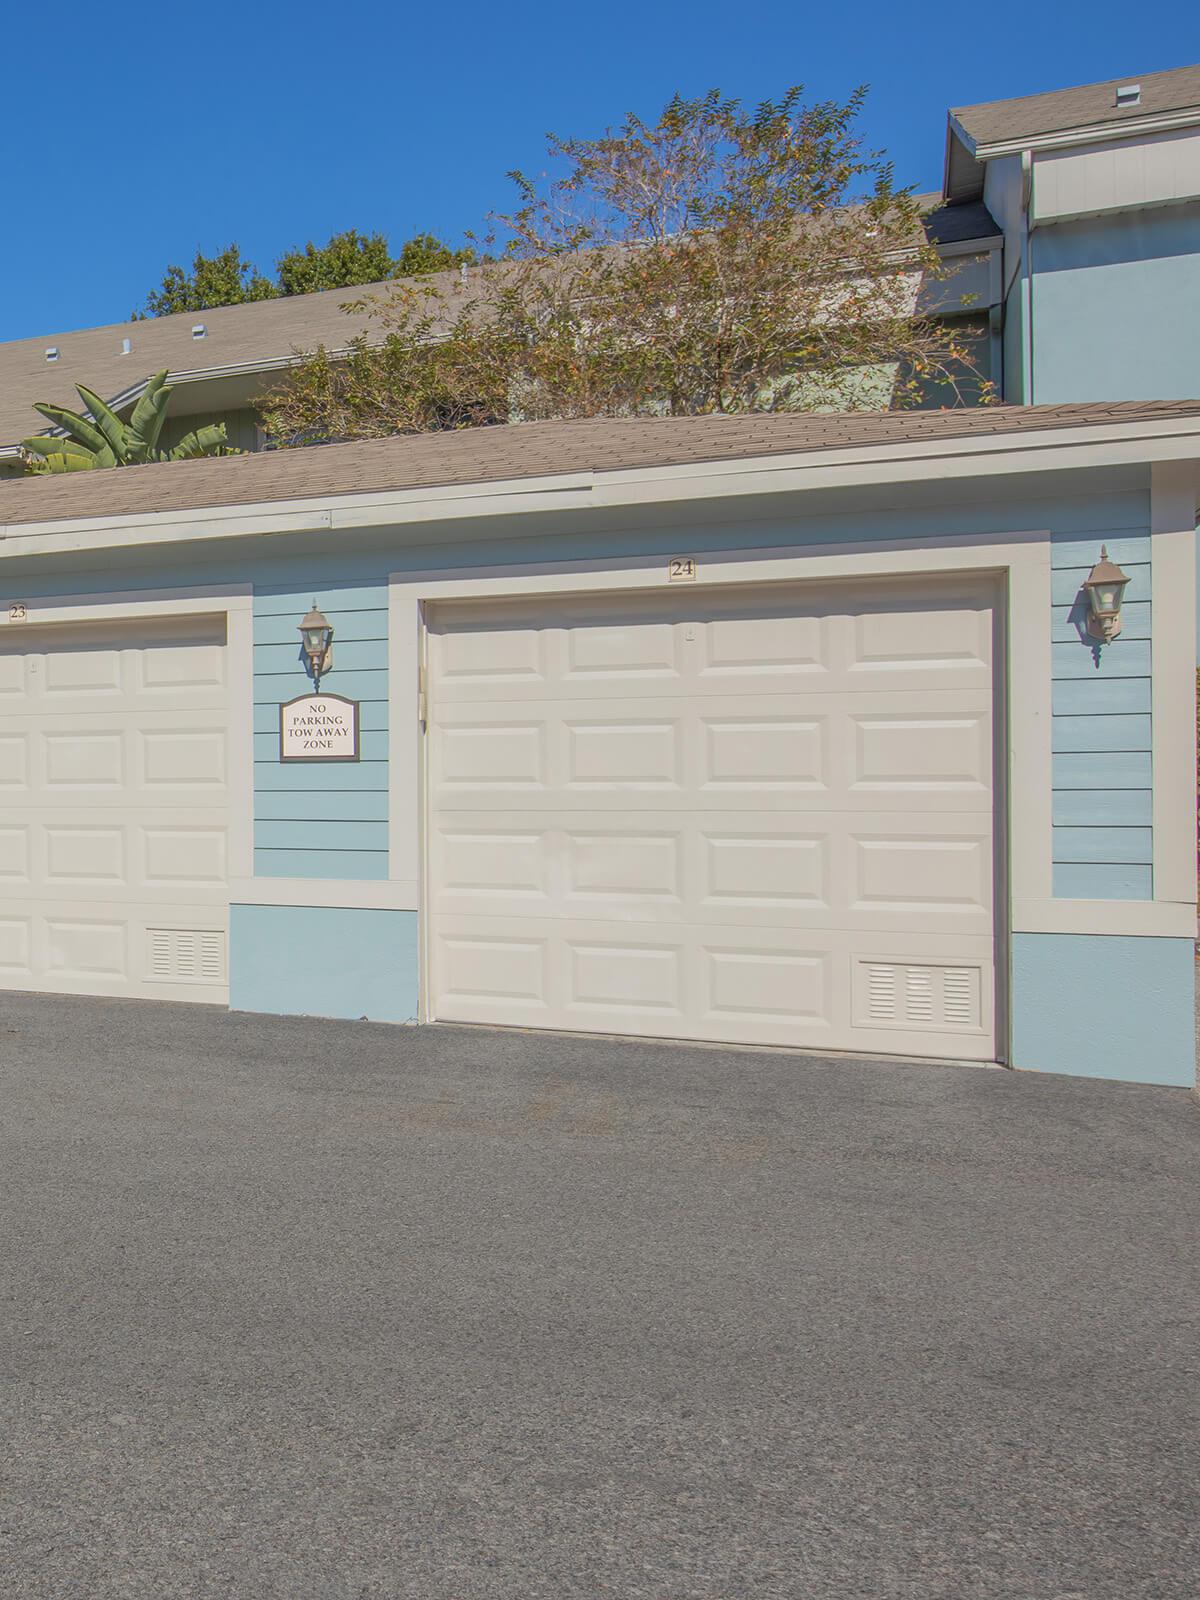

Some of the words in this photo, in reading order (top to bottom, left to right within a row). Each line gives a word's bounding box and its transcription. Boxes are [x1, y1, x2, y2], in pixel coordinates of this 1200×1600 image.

[671, 560, 693, 576] 24
[11, 605, 25, 618] 23
[309, 704, 326, 713] NO
[293, 715, 343, 725] PARKING
[288, 728, 313, 737] TOW
[315, 727, 349, 737] AWAY
[303, 739, 334, 749] ZONE
